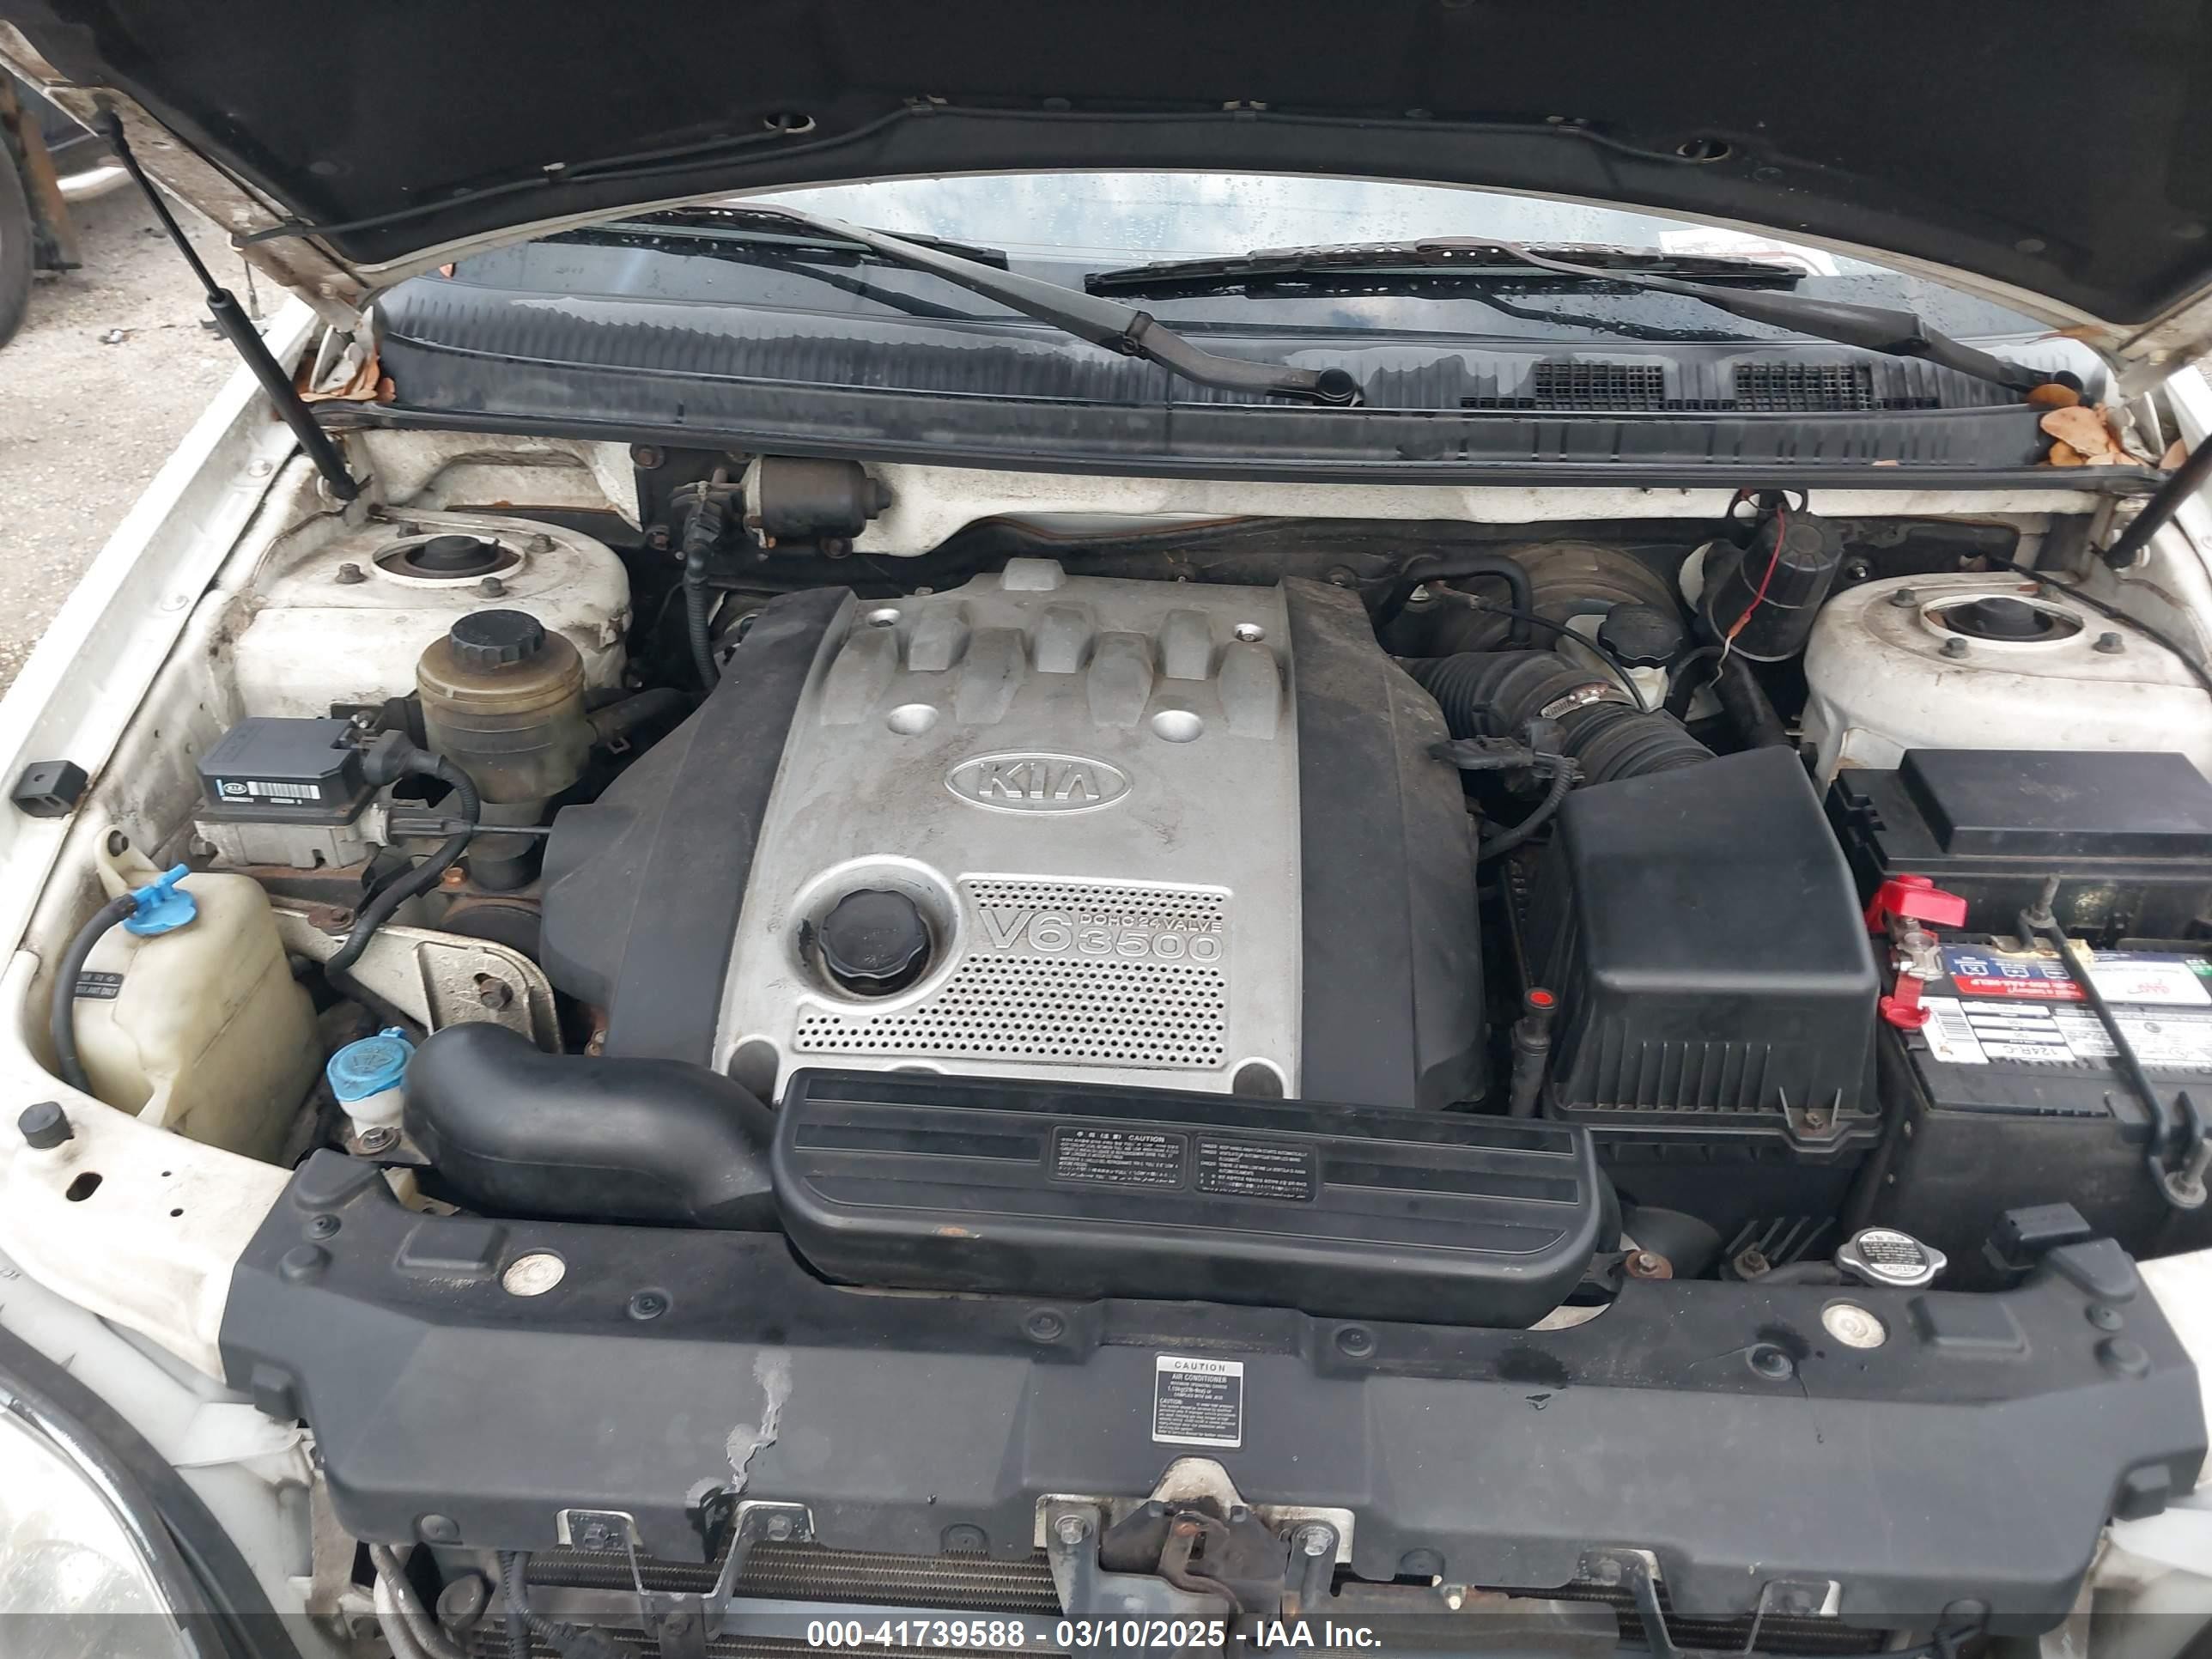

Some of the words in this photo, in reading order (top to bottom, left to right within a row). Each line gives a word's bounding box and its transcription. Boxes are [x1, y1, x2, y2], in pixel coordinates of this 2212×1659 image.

[978, 763, 1100, 800] KIA
[1079, 913, 1135, 927] DOHC
[1138, 915, 1160, 929] 24
[1162, 918, 1224, 934] VALVE
[978, 908, 1073, 952] V6
[1077, 927, 1223, 963] 3500
[1128, 1134, 1165, 1143] CAUTION
[1174, 1361, 1225, 1372] CAUTION
[1185, 1374, 1228, 1383] CONDITIONER
